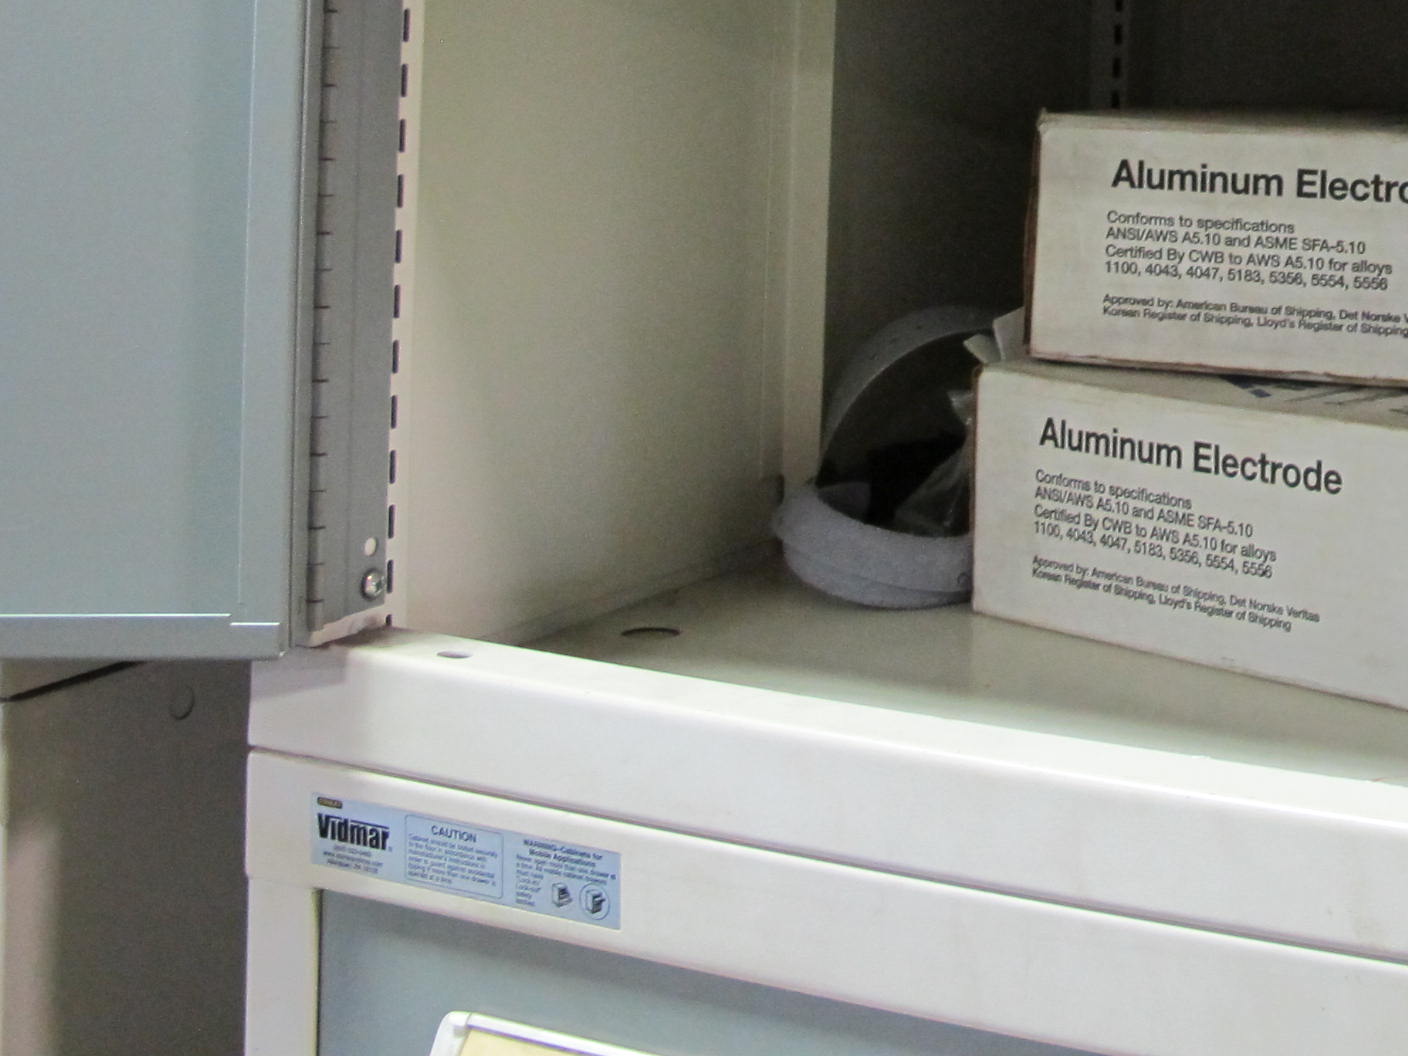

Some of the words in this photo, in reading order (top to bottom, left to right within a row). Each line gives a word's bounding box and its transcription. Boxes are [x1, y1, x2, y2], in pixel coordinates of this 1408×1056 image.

[1112, 159, 1283, 197] Aluminum
[1106, 210, 1177, 229] Conforms
[1180, 215, 1196, 230] to
[1197, 217, 1295, 237] specifications
[1106, 227, 1178, 243] ANSI/AWS
[1180, 231, 1221, 246] A5.10
[1224, 234, 1251, 248] and
[1254, 235, 1298, 251] ASME
[1302, 237, 1366, 254] SFA-5.10
[1104, 243, 1166, 263] Certified
[1164, 248, 1185, 267] By
[1188, 249, 1224, 266] CWB
[1228, 252, 1243, 267] to
[1246, 252, 1283, 269] AWS
[1282, 255, 1326, 271] A5.10
[1328, 257, 1349, 272] for
[1350, 259, 1392, 277] alloys
[1104, 260, 1141, 277] 1100,
[1144, 263, 1182, 280] 4043,
[1186, 265, 1223, 282] 4047,
[1040, 417, 1182, 469] Aluminum
[1192, 440, 1342, 494] Electrode
[1036, 468, 1093, 494] Conforms
[1095, 481, 1108, 496] to
[1109, 484, 1192, 510] specifications
[1034, 485, 1094, 509] ANSI/AWS
[1096, 496, 1129, 515] A5.10
[1132, 505, 1157, 522] and
[1156, 507, 1195, 528] ASME
[1196, 514, 1253, 538] SFA-5.10
[1034, 503, 1081, 526] Certified
[1084, 512, 1099, 532] By
[1102, 516, 1132, 535] CWB
[1134, 523, 1150, 539] to
[1148, 525, 1180, 544] AWS
[1182, 532, 1217, 551] A5.10
[1220, 538, 1238, 554] for
[1240, 543, 1276, 563] alloys
[1034, 520, 1063, 540] 1100,
[1066, 526, 1096, 547] 4043,
[1098, 533, 1131, 553] 4047,
[317, 813, 390, 851] Vidmar
[431, 825, 477, 843] CAUTION
